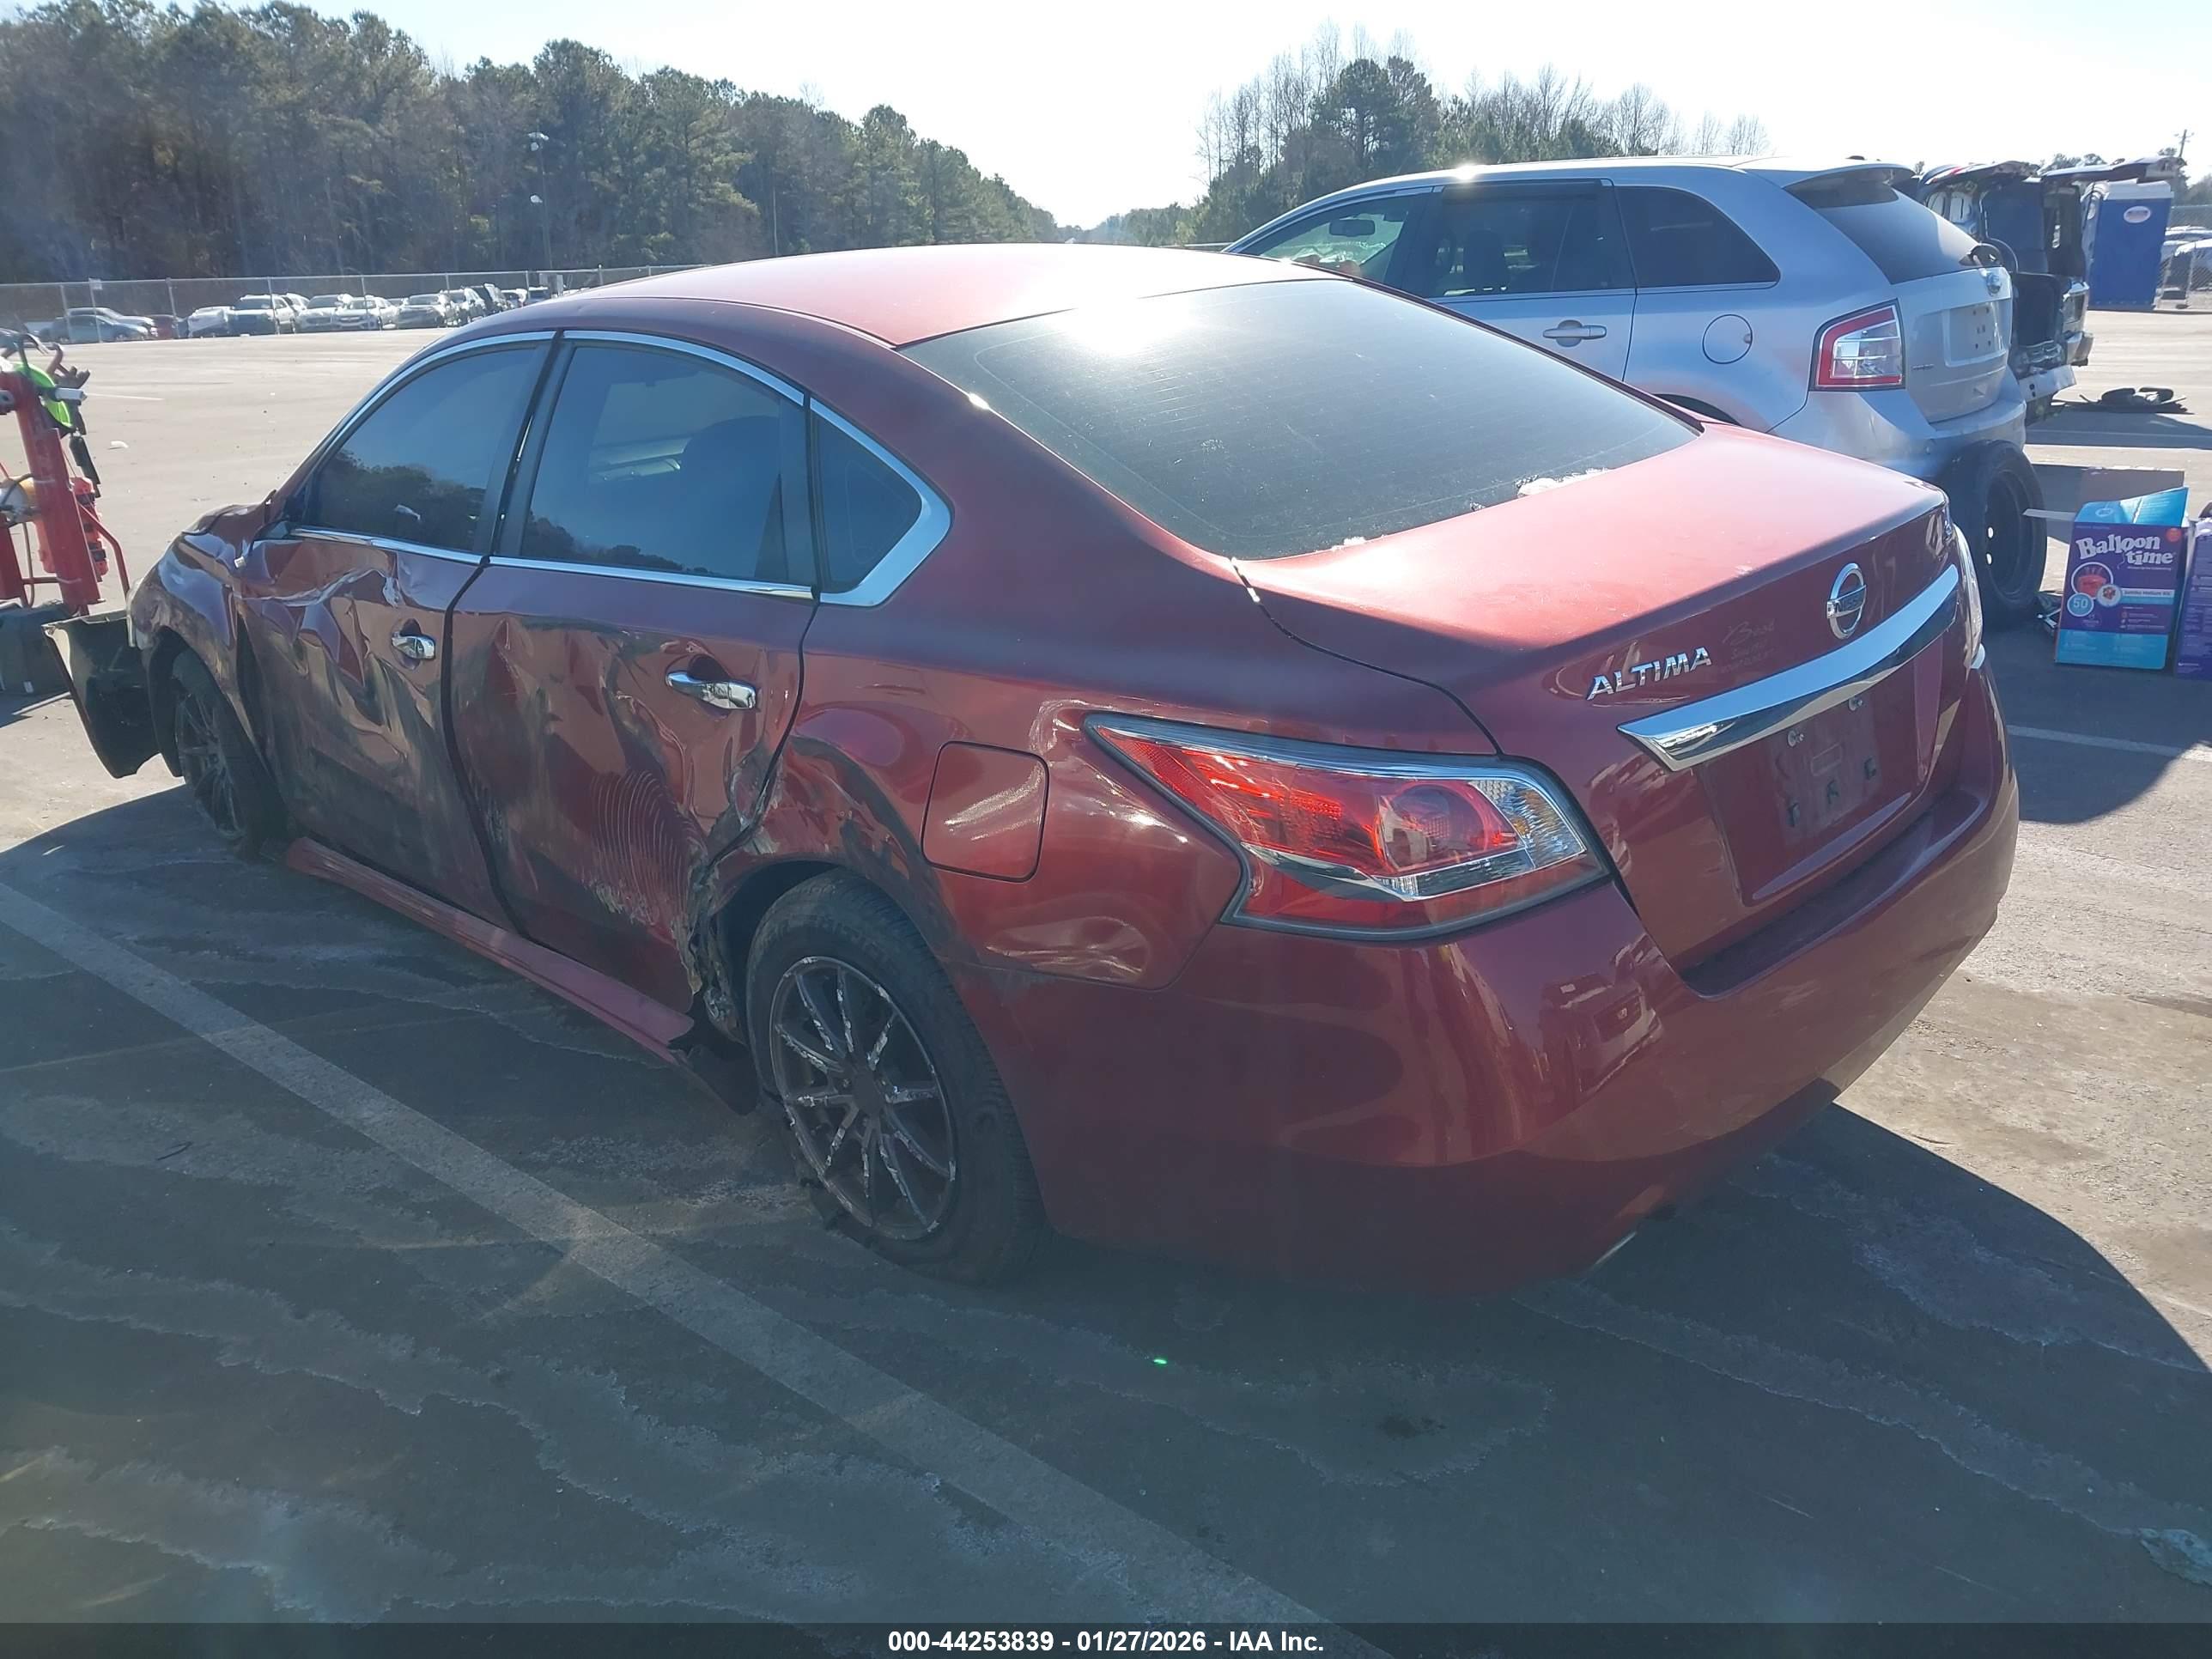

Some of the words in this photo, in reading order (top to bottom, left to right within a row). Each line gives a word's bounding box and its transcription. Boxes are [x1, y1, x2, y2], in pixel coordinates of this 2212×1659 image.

[2075, 534, 2160, 560] Balloon
[2125, 550, 2173, 565] time
[2073, 598, 2089, 609] 50
[1586, 646, 1712, 701] ALTIMA
